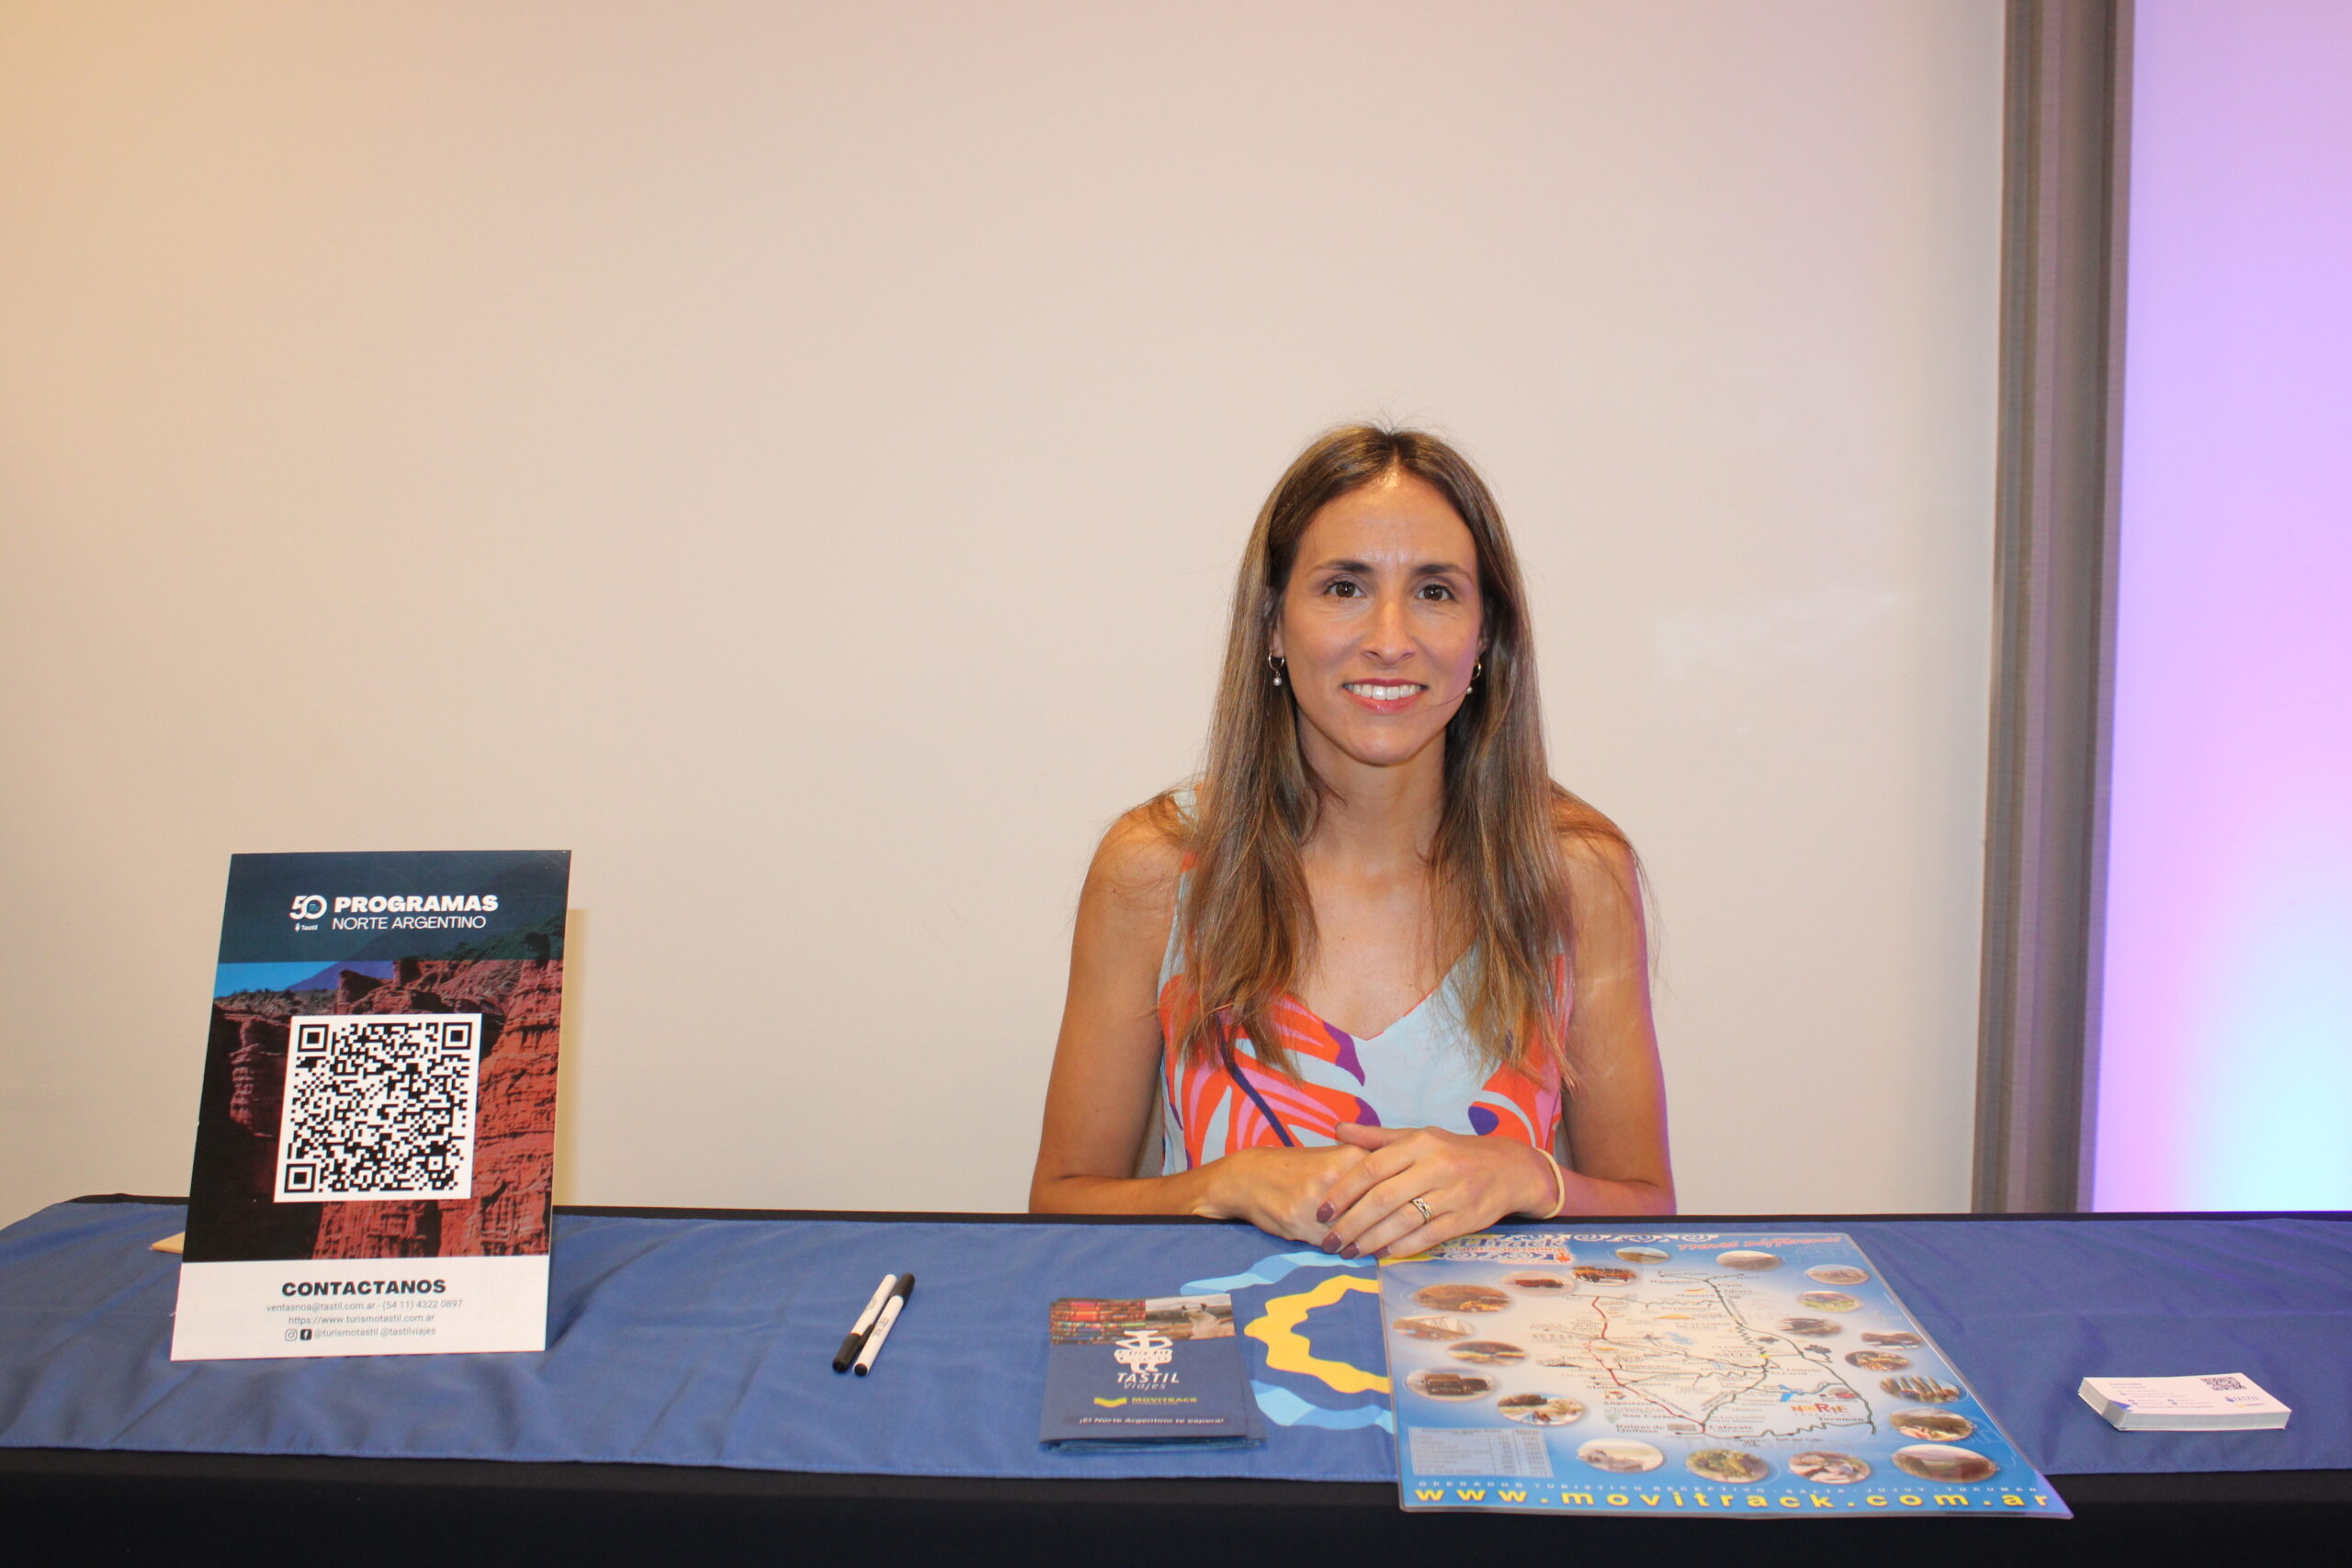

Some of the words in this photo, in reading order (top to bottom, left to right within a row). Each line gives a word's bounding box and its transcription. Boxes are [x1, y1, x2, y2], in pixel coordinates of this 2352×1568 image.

[334, 894, 499, 913] PROGRAMAS
[332, 917, 388, 931] NORTE
[390, 915, 486, 930] ARGENTINO
[281, 1279, 447, 1296] CONTACTANOS
[266, 1302, 375, 1313] ventasnoa@tastil.com.ar
[382, 1301, 398, 1311] (54
[401, 1300, 413, 1310] 11)
[416, 1300, 438, 1309] 4322
[440, 1299, 463, 1308] 0897
[288, 1314, 435, 1325] https://www.turismotastil.com.ar
[313, 1327, 379, 1338] @turismotastil
[379, 1326, 436, 1337] @tastilviajes
[1115, 1371, 1181, 1383] TASTIL
[1414, 1489, 2050, 1508] www.movitrack.com.ar
